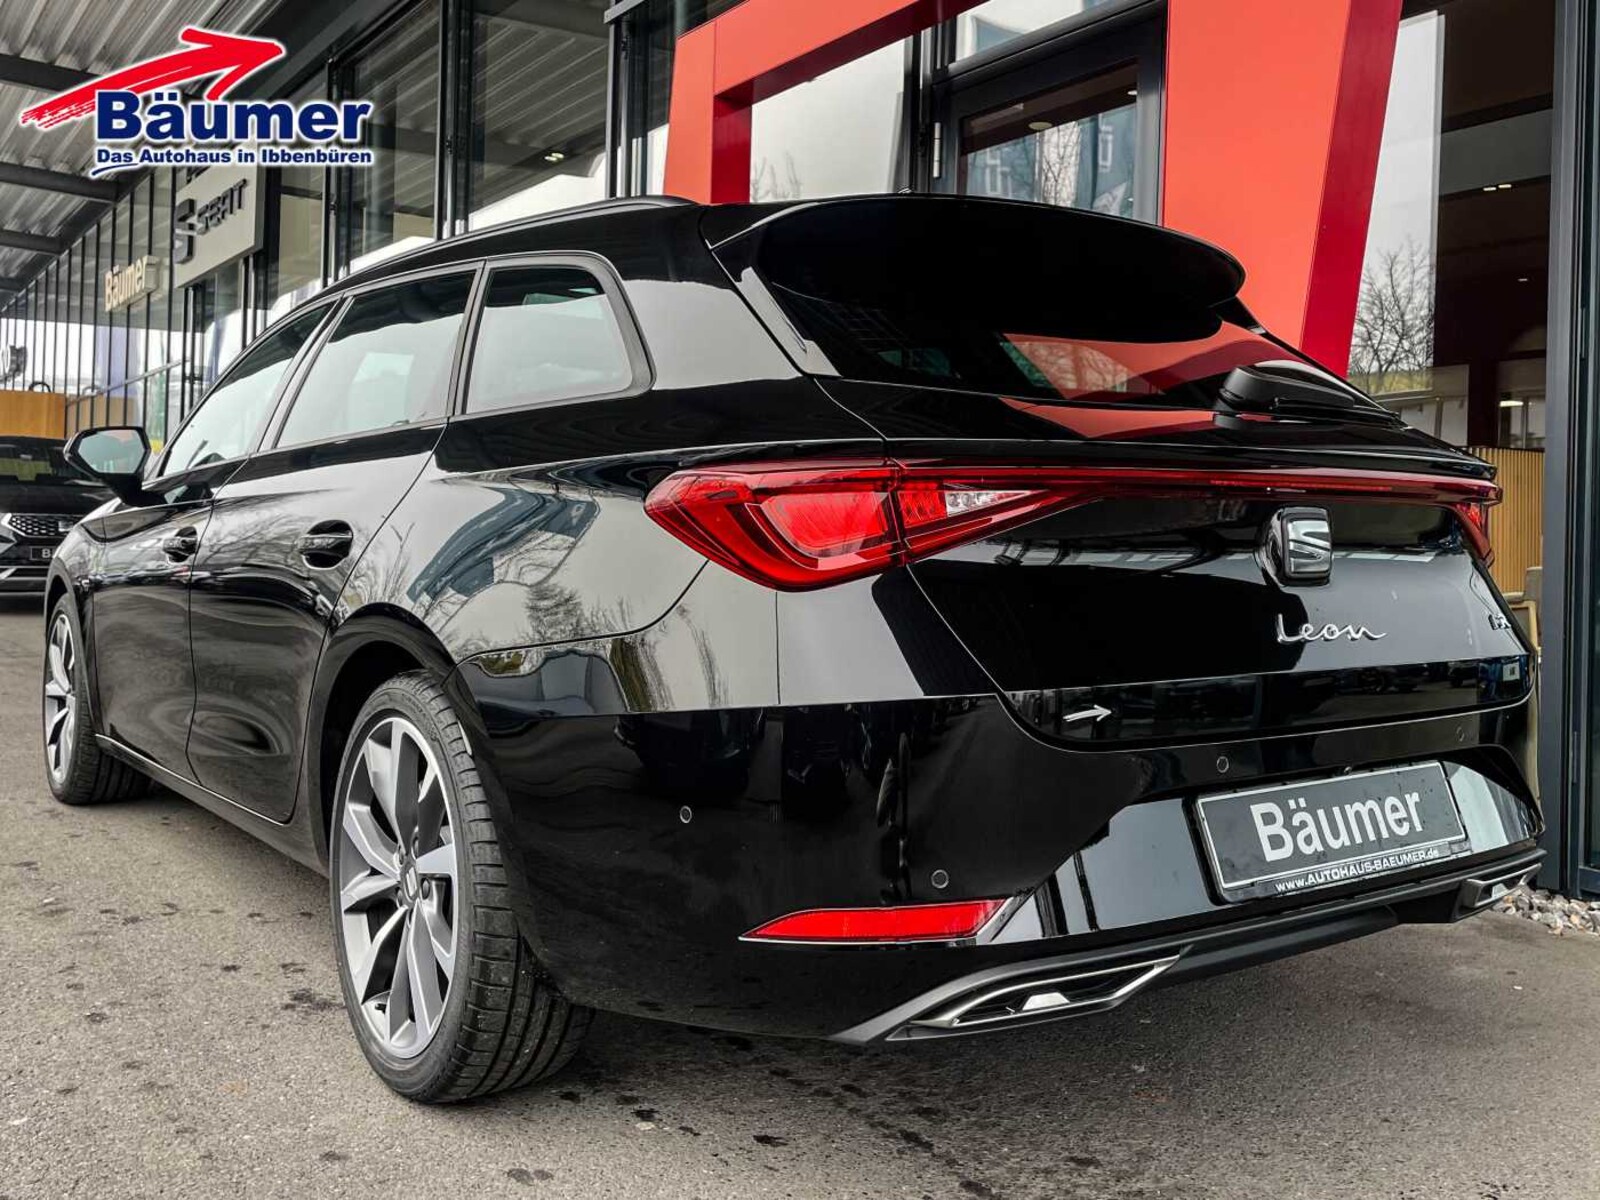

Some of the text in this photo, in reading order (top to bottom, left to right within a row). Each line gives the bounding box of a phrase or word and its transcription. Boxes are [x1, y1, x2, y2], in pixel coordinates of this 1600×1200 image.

[196, 178, 249, 236] SEAT
[104, 255, 148, 312] Bäumer
[1276, 613, 1387, 644] Leon
[1250, 791, 1423, 862] Bäumer
[1275, 848, 1440, 893] www.AUTOHAUS-BAEUMER.de
